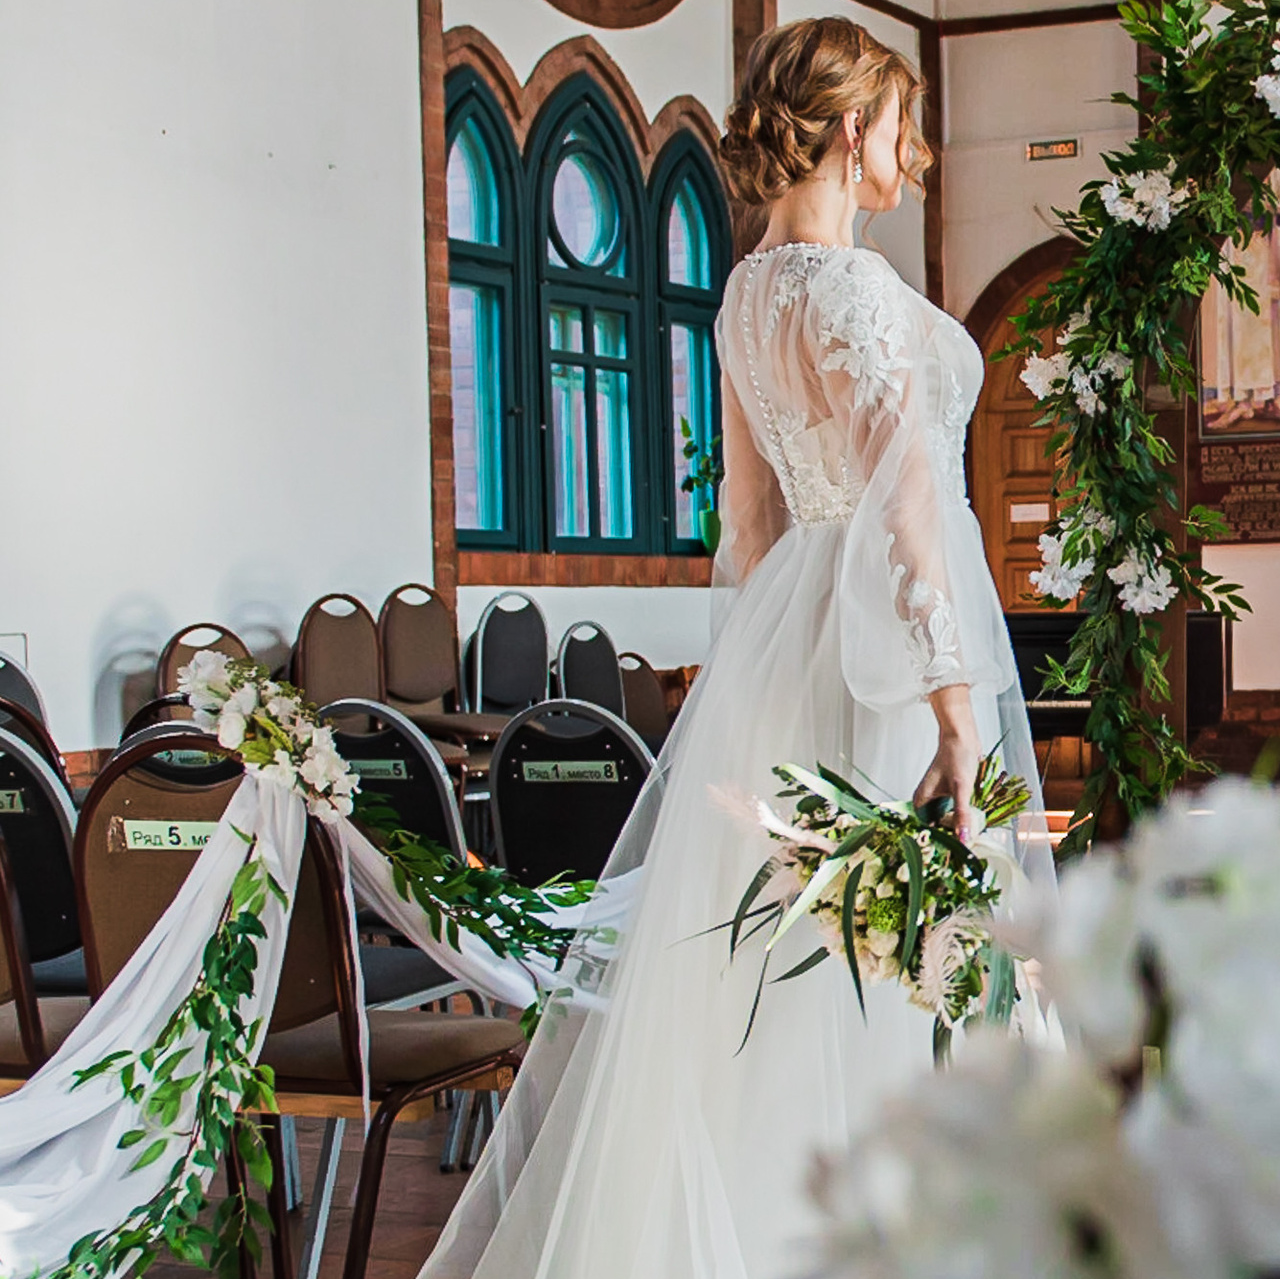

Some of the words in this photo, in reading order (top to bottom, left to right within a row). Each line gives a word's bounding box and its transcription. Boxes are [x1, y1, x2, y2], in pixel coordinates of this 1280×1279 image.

[392, 762, 402, 776] 5
[528, 767, 549, 779] Ряд
[603, 763, 615, 778] 8
[5, 792, 17, 809] 7
[133, 831, 164, 847] Ряд
